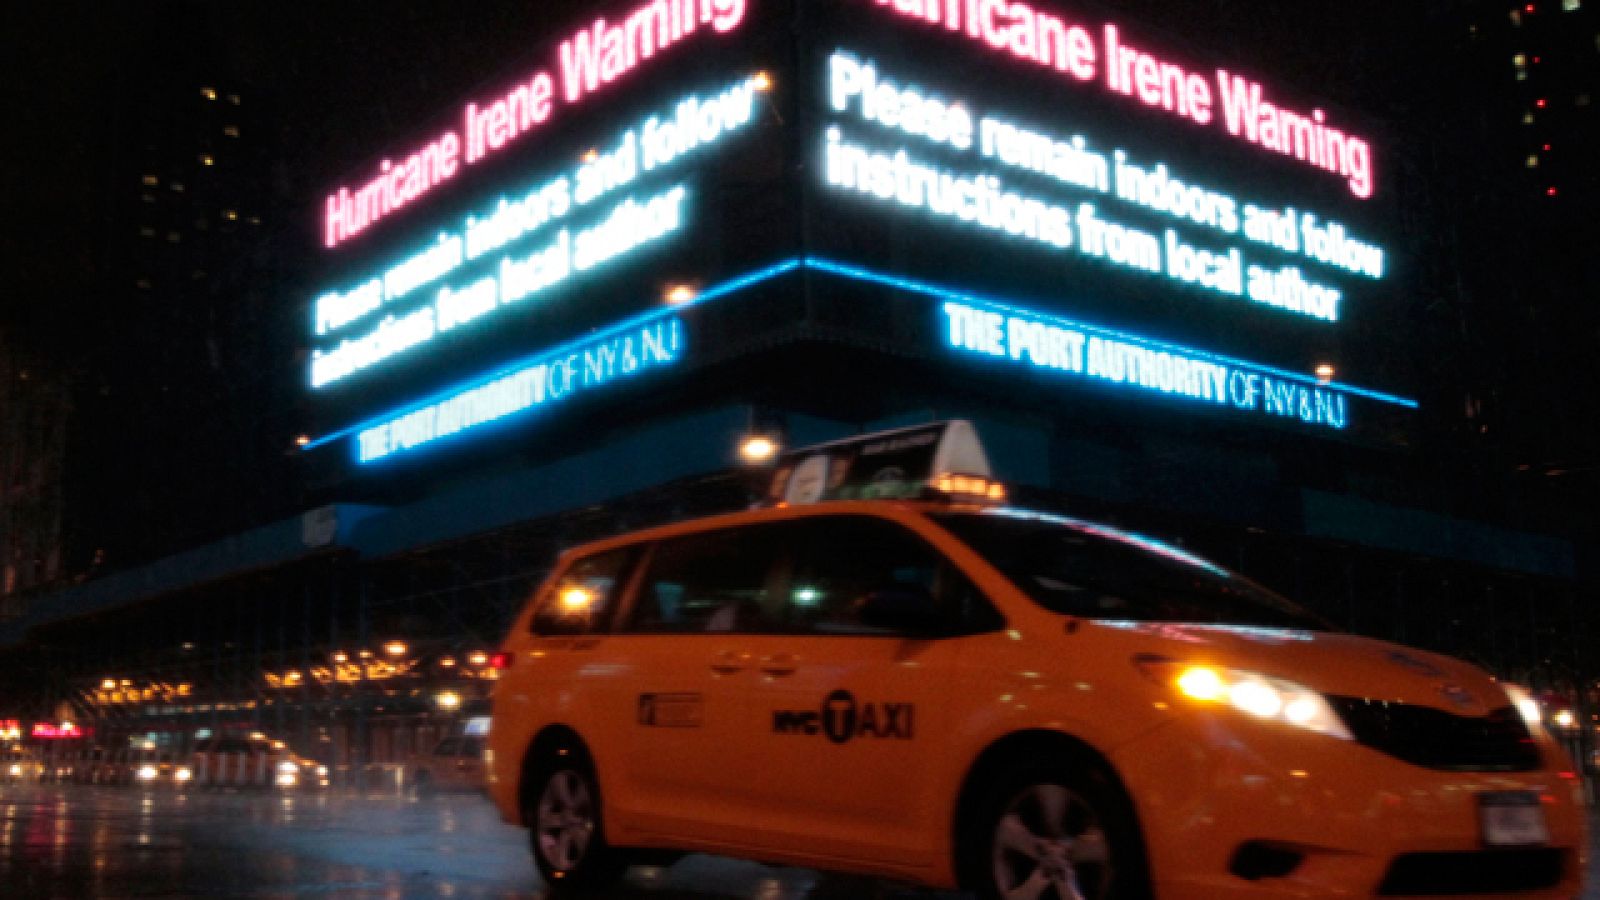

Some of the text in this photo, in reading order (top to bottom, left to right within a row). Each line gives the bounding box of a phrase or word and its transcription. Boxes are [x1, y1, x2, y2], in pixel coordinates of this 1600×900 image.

[324, 132, 459, 248] Hurricane
[464, 72, 552, 163] Irene
[465, 177, 571, 260] indoors
[573, 130, 636, 205] and
[641, 80, 756, 171] follow
[828, 49, 1385, 279] Please remain indoors and follow
[1104, 23, 1211, 123] Irene
[1217, 69, 1373, 199] Warning
[500, 228, 571, 303] local
[574, 186, 684, 270] author
[825, 126, 1342, 323] instructions from local author
[358, 424, 388, 464] THE
[389, 405, 437, 452] PORT
[438, 365, 546, 438] AUTHORITY
[549, 355, 578, 399] OF
[585, 338, 619, 385] NY
[621, 336, 637, 373] &
[944, 302, 1345, 429] THE PORT AUTHORITY OF NY & NJ
[772, 689, 915, 744] NYC TAXI
